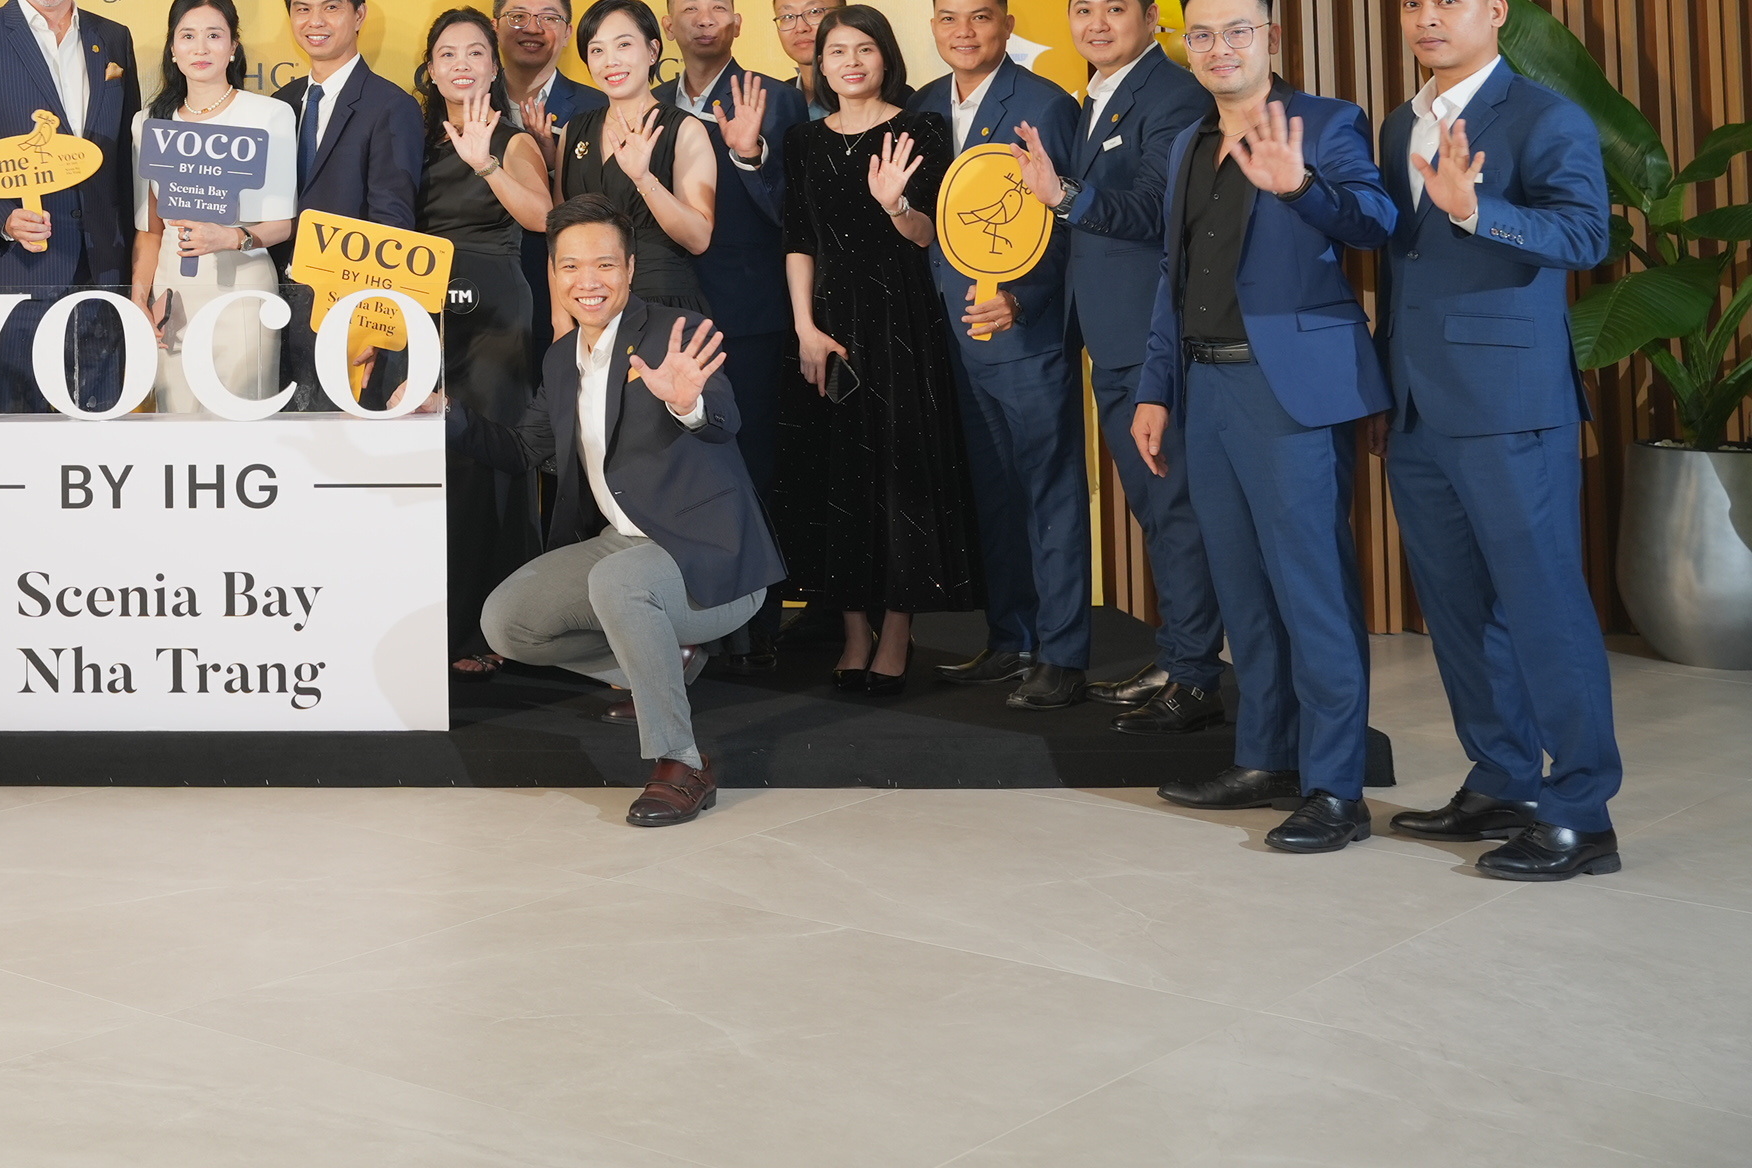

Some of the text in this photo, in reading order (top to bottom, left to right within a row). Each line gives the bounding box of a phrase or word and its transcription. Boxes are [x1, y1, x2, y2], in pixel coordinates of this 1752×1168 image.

[1, 166, 55, 190] on in
[179, 162, 223, 176] BY IHG
[169, 181, 228, 200] Scenia Bay
[168, 196, 227, 215] Nha Trang
[342, 269, 393, 290] BY IHG
[448, 290, 473, 303] TM
[374, 301, 398, 319] Bay
[357, 314, 396, 337] Trang
[60, 463, 279, 509] BY IHG
[17, 571, 323, 632] Scenia Bay
[16, 646, 326, 710] Nha Trang
